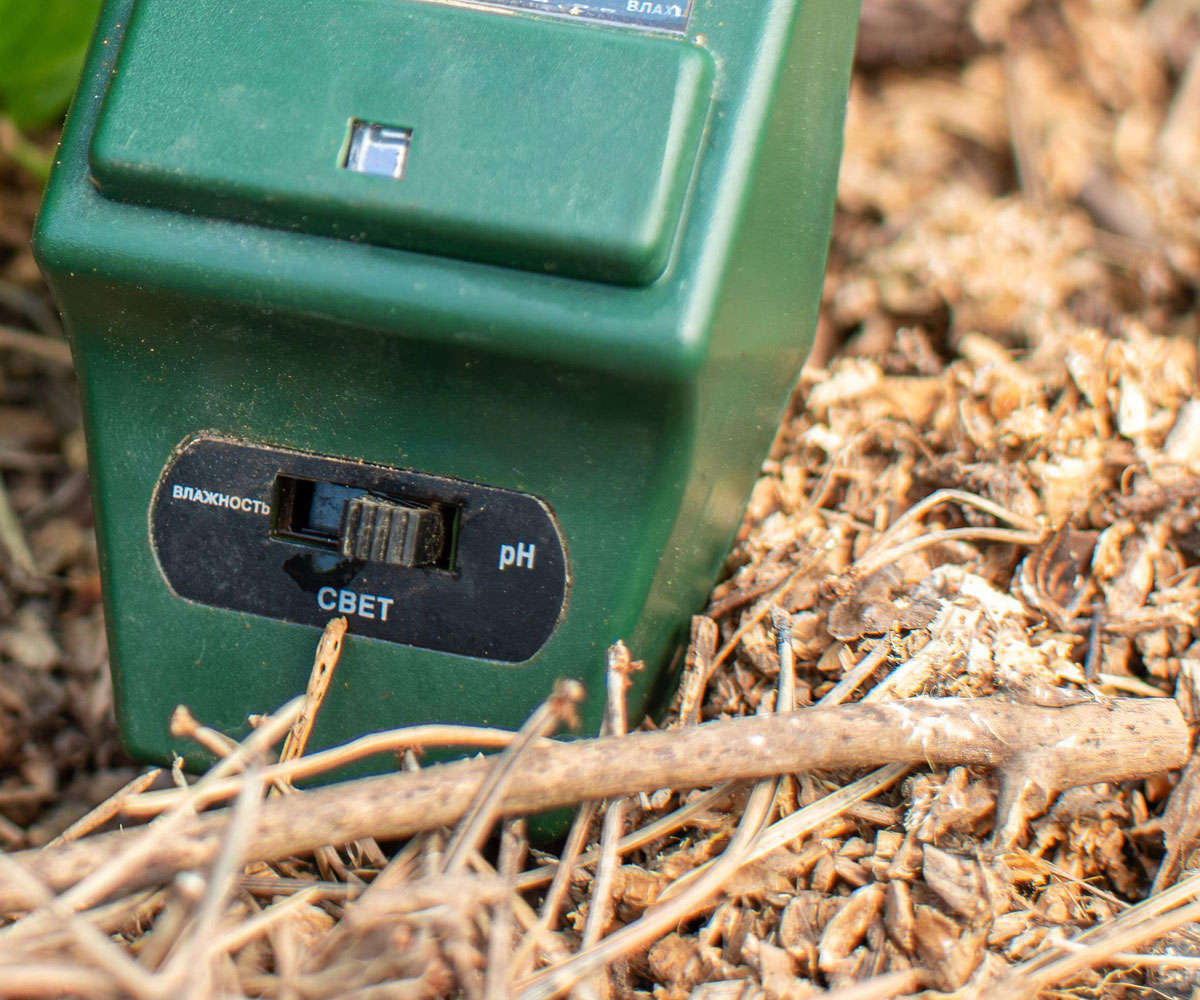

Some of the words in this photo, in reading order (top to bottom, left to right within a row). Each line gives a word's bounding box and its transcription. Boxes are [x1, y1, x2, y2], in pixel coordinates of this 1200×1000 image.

[172, 484, 271, 516] ВЛАЖНОСТЬ
[499, 542, 536, 570] pH
[317, 586, 394, 622] СВЕТ
